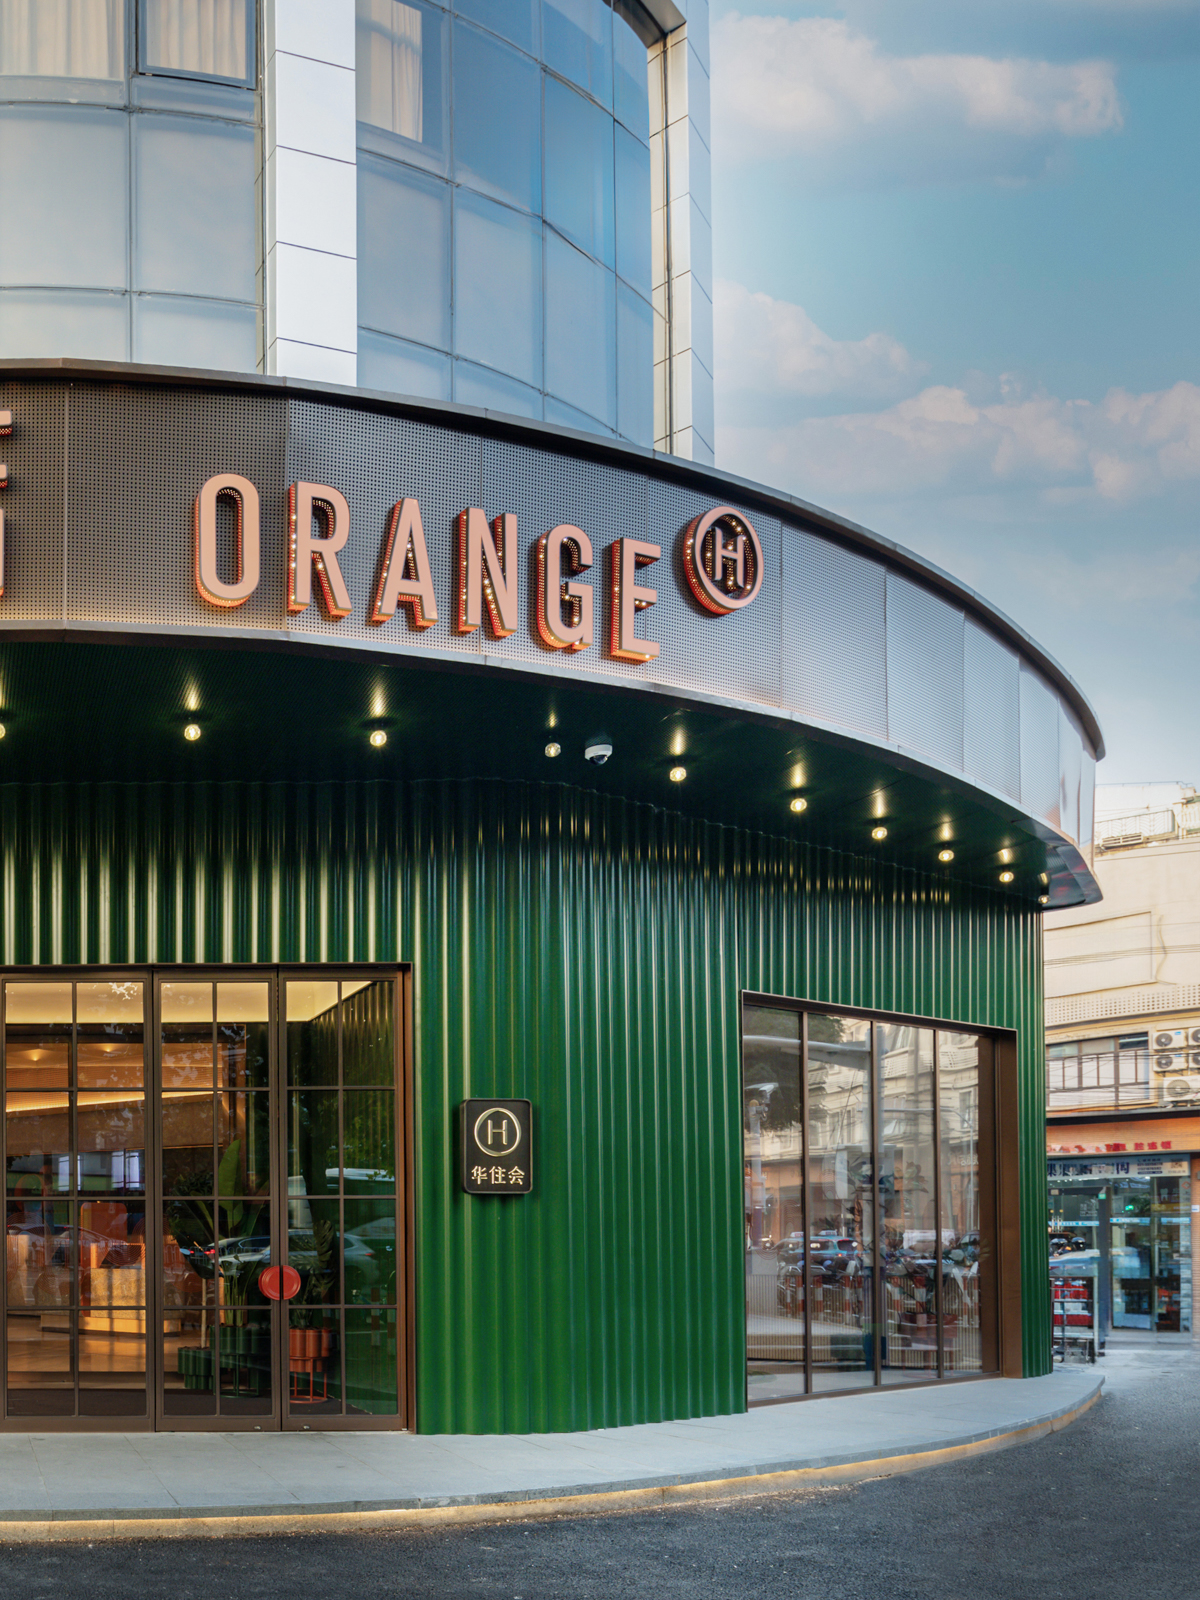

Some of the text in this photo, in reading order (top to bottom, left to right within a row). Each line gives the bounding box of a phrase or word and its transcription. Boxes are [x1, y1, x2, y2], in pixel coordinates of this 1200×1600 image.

[197, 473, 661, 660] ORANGE
[471, 1165, 525, 1185] 华住会
